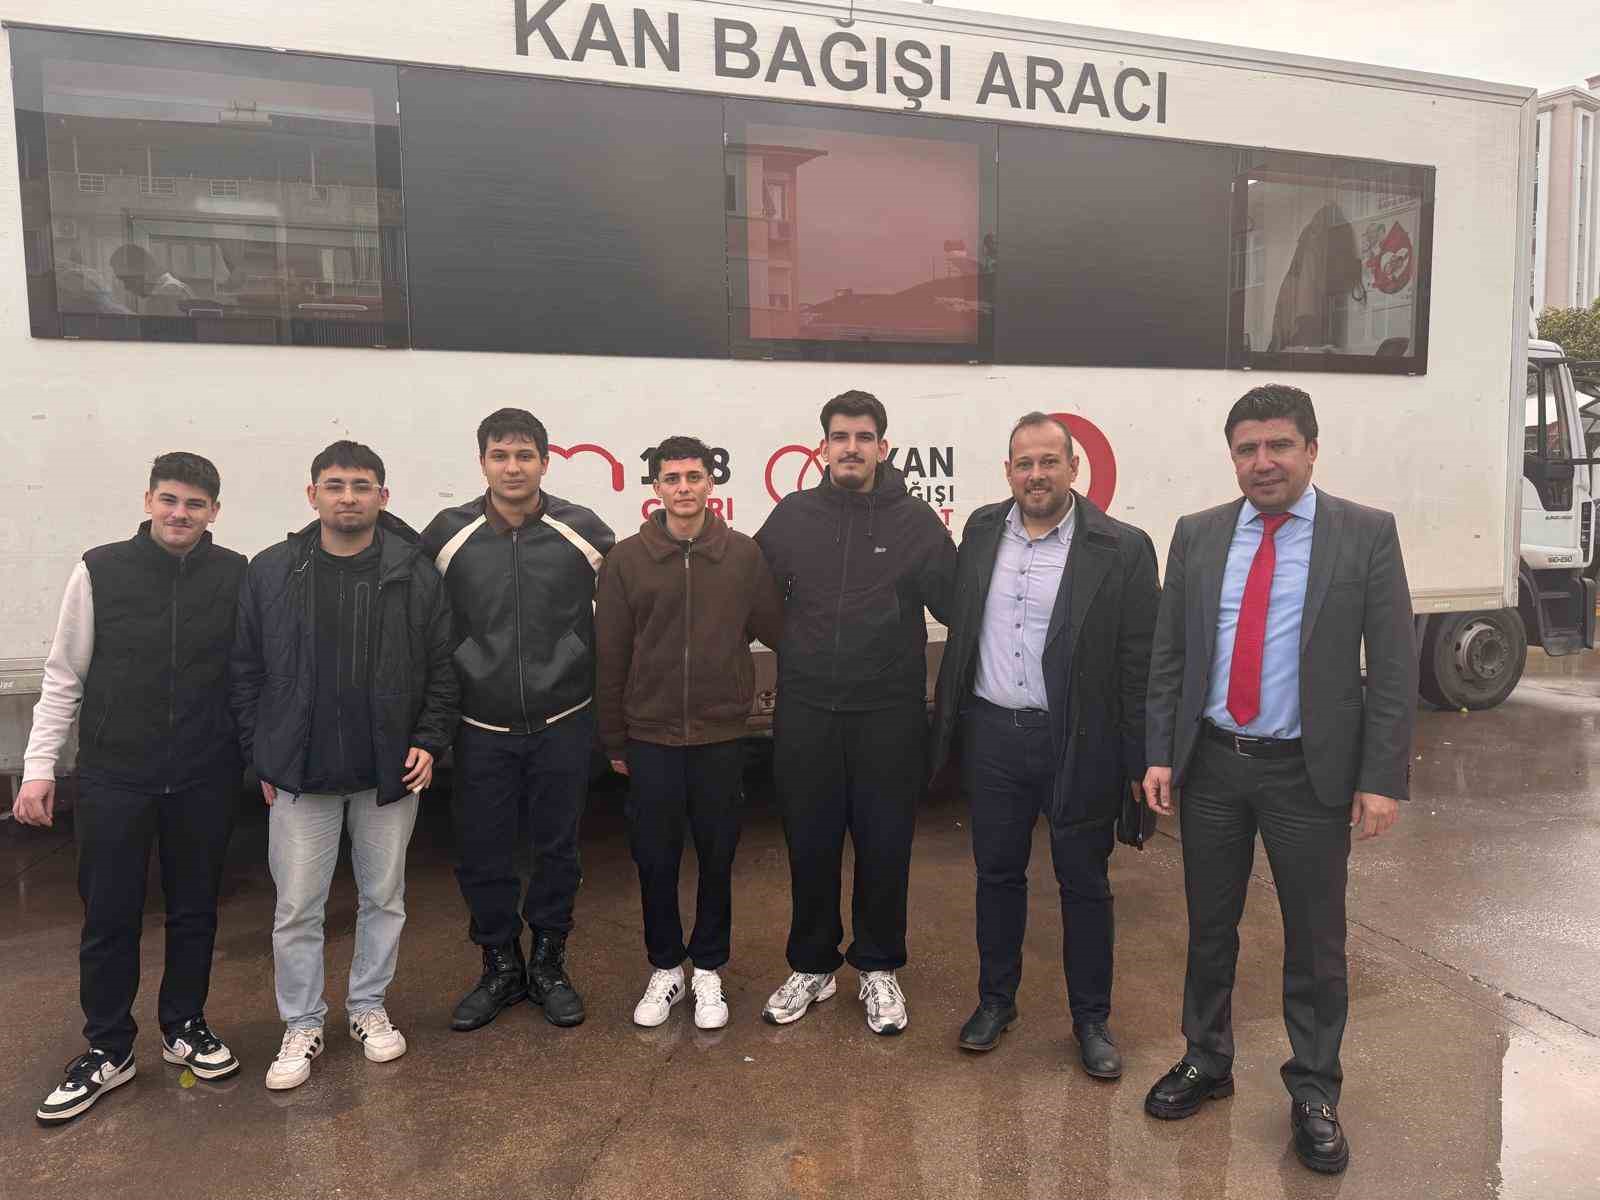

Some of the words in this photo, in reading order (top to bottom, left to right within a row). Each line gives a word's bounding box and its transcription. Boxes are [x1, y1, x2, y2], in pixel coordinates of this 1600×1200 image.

[514, 0, 680, 73] KAN
[713, 17, 951, 111] BAĞIŞI
[976, 51, 1167, 124] ARACI
[640, 447, 731, 485] 18
[905, 481, 954, 507] ĞIŞI
